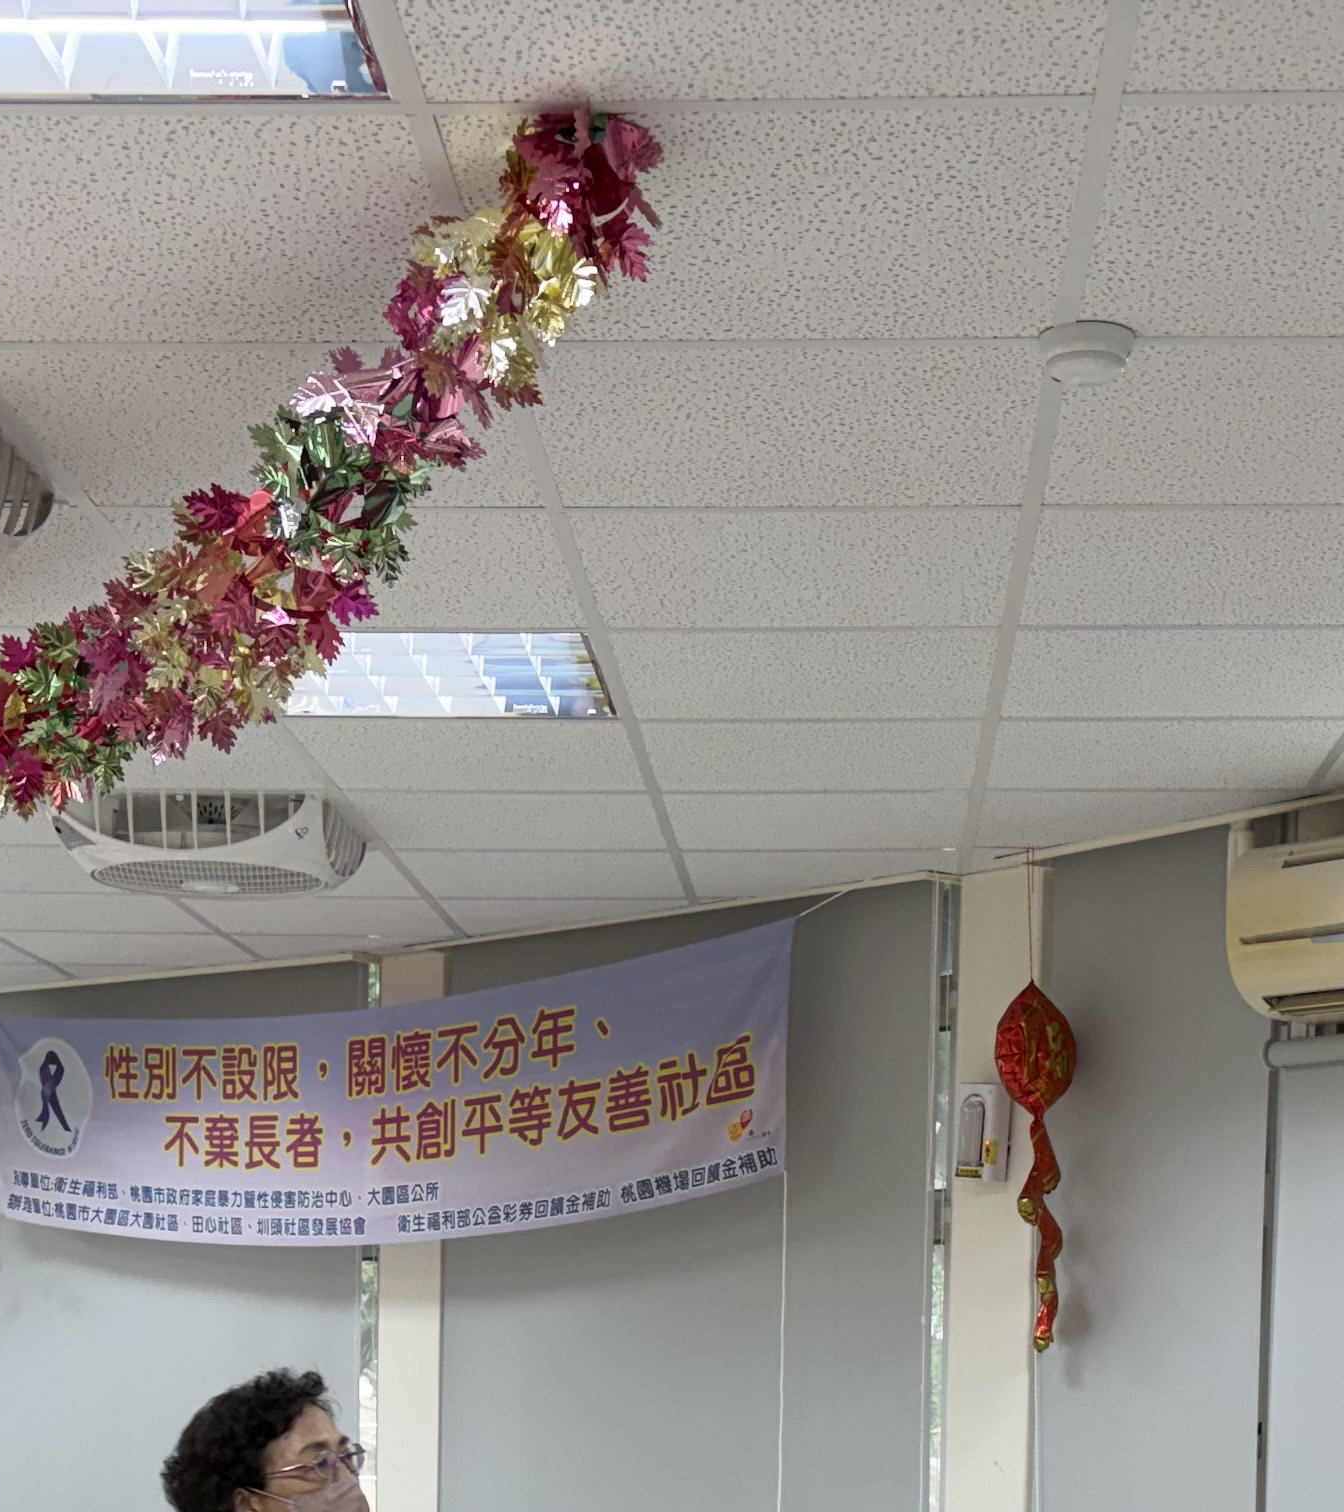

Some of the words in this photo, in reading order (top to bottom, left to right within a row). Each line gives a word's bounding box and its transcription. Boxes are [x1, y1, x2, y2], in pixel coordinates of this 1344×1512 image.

[104, 1007, 611, 1102] 性別不設限，關懷不分年、
[163, 1032, 756, 1170] 不棄長者，共創平等友善社區
